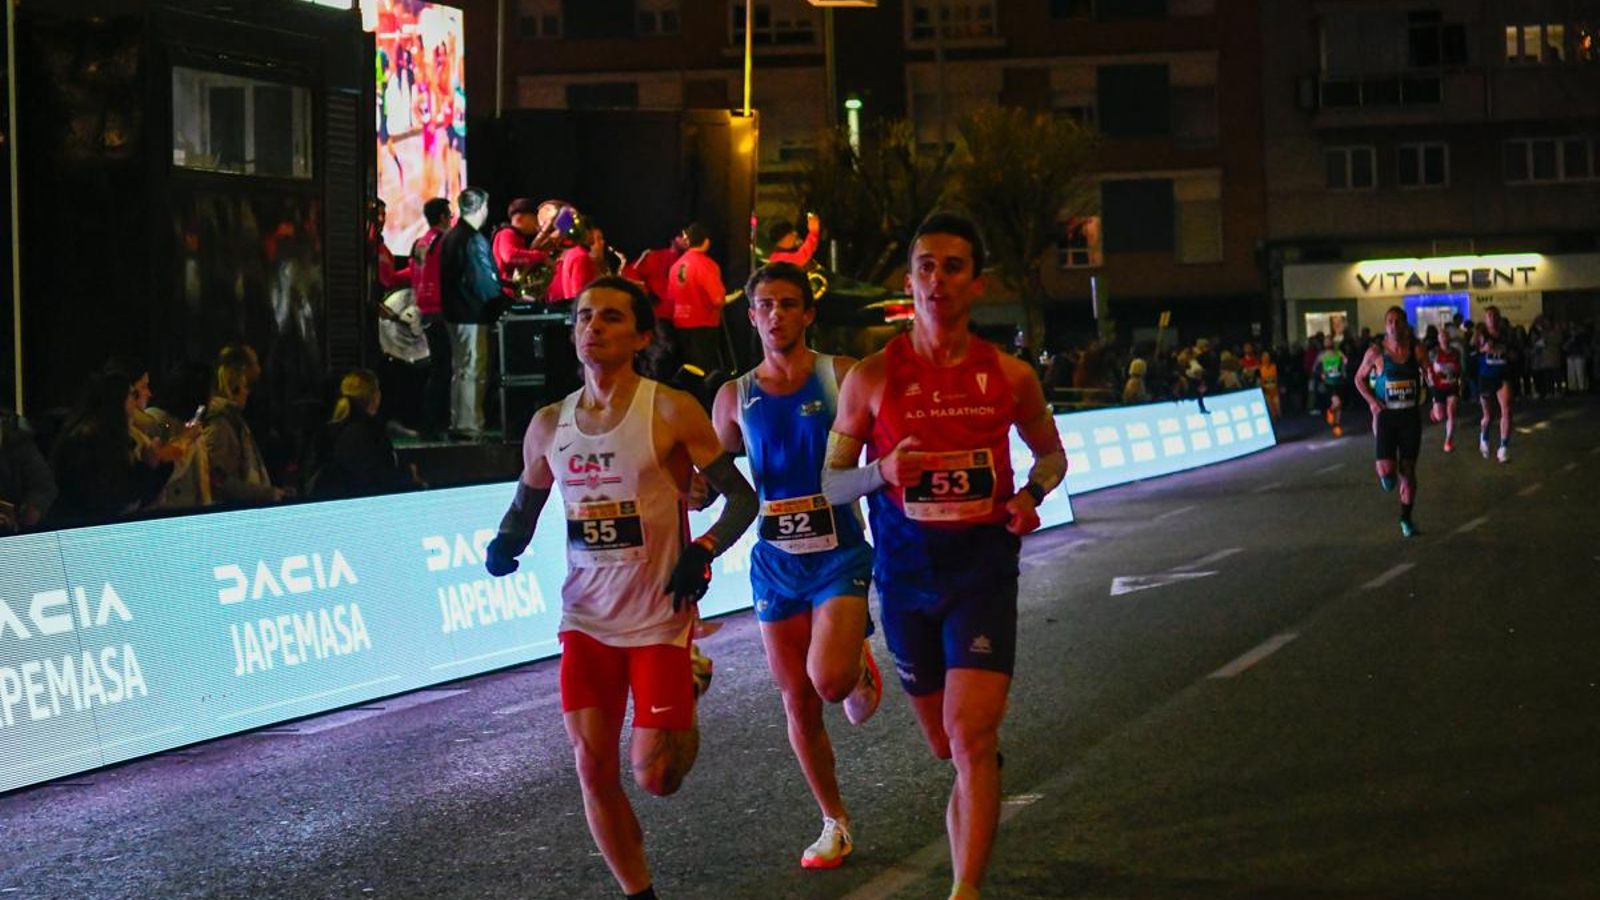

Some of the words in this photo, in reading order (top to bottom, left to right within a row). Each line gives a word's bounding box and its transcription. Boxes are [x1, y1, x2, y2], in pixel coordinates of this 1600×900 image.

[1356, 266, 1536, 291] VITALDENT
[929, 406, 995, 417] MARATHON
[568, 452, 615, 474] CAT
[931, 470, 970, 495] 53
[583, 520, 617, 544] 55
[778, 512, 812, 535] 52
[421, 528, 534, 572] DAC
[213, 549, 359, 606] DACIA
[438, 571, 547, 635] JAPEMASA
[229, 602, 372, 678] JAPEMASA
[0, 644, 148, 726] PEMASA
